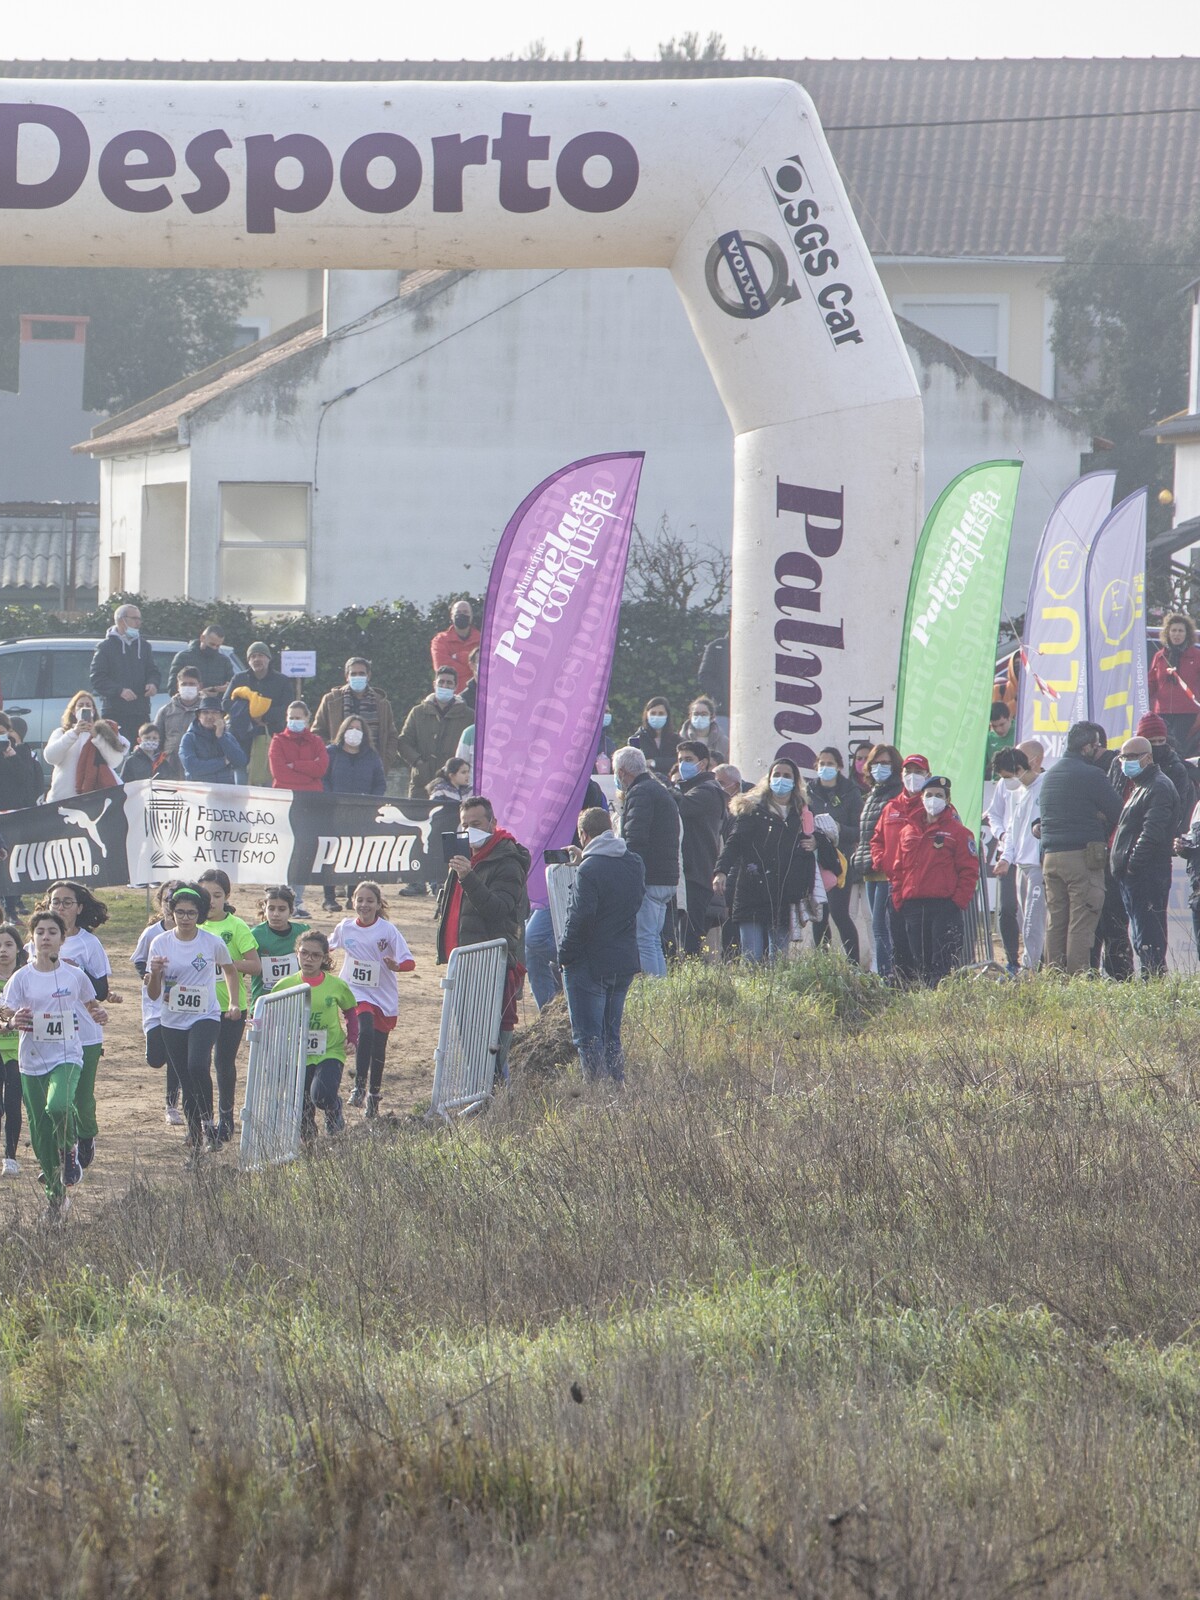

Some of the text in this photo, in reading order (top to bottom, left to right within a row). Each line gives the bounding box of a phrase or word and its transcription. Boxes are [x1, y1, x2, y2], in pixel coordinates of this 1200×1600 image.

[728, 237, 763, 311] VOLVO
[783, 199, 864, 346] SGS Car
[513, 542, 547, 597] Município
[542, 489, 623, 623] conquista
[944, 490, 1006, 610] conquista
[494, 513, 582, 667] Palmela
[912, 510, 977, 648] Palmela
[195, 826, 279, 845] PORTUGUESA
[197, 805, 275, 825] FEDERAÇÃO
[9, 836, 93, 883] PUMA
[194, 848, 275, 864] ATLETISMO
[311, 835, 417, 874] PUMA
[271, 963, 291, 977] 677
[352, 967, 372, 982] 451
[177, 993, 201, 1008] 346
[46, 1021, 63, 1036] 44
